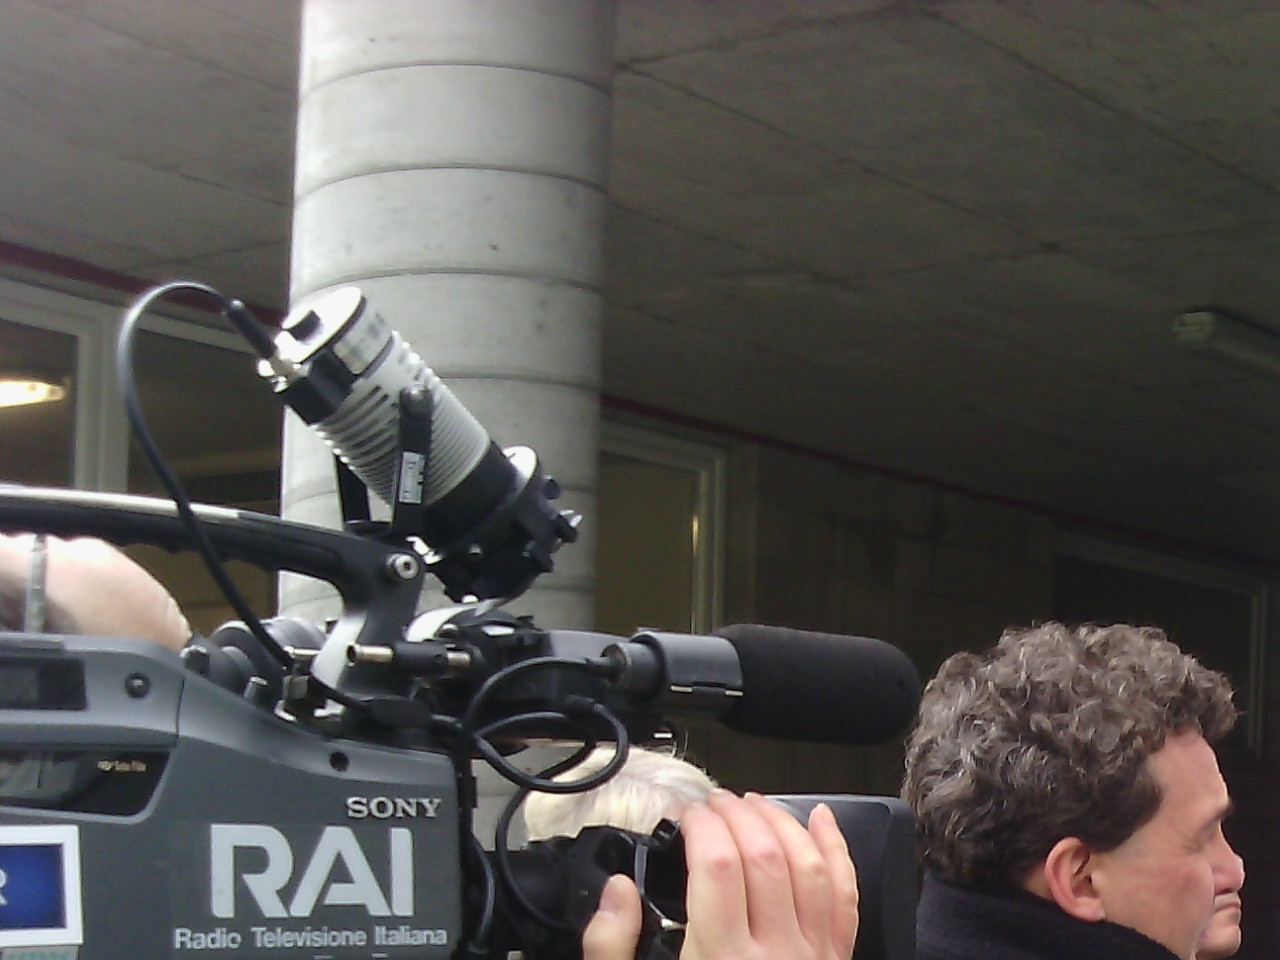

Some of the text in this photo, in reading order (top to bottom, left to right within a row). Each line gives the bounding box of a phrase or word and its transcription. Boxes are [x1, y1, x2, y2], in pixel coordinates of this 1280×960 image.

[346, 796, 442, 819] SONY
[210, 823, 414, 919] RAI
[173, 925, 447, 950] Radio Televisione Italiana
